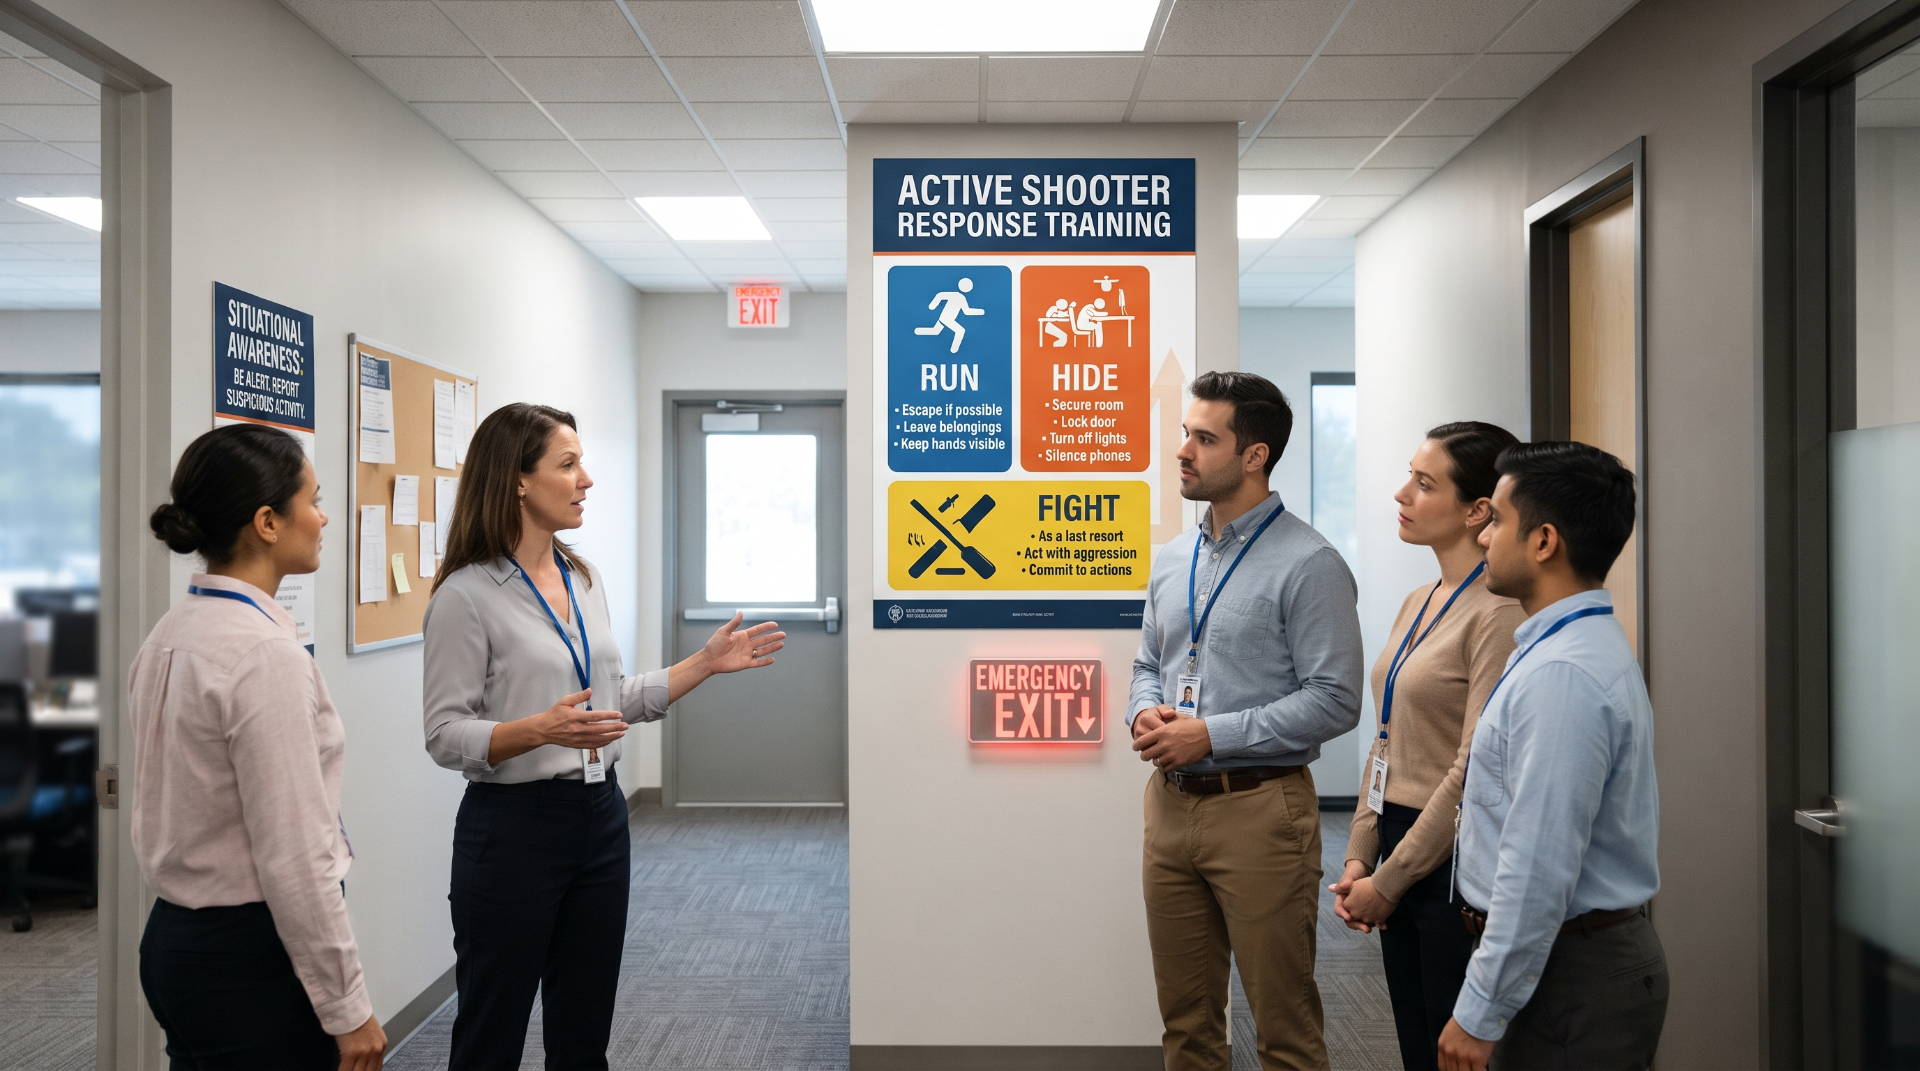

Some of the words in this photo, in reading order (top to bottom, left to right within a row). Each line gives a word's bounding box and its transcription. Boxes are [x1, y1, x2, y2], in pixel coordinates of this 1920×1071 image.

[897, 174, 1013, 206] ACTIVE
[1021, 174, 1171, 206] SHOOTER
[898, 211, 1038, 238] RESPONSE
[1044, 211, 1171, 238] TRAINING
[228, 299, 305, 347] SITUATIONAL
[740, 298, 778, 325] EXIT
[227, 331, 304, 376] AWARENESS:
[233, 367, 245, 386] BE
[245, 370, 271, 392] ALERT.
[272, 376, 300, 398] REPORT
[920, 363, 979, 392] RUN
[1052, 363, 1119, 391] HIDE
[226, 388, 274, 414] SUSPICIOUS
[274, 398, 306, 420] ACTIVITY.
[902, 403, 943, 418] Escape
[945, 403, 954, 416] if
[955, 403, 1003, 418] possible
[1052, 398, 1092, 411] Secure
[1094, 401, 1124, 411] room
[903, 420, 937, 433] Leave
[939, 420, 1002, 436] belongings
[1061, 415, 1089, 428] Lock
[1090, 415, 1117, 428] door
[901, 437, 930, 452] Keep
[931, 437, 967, 450] hands
[968, 437, 1005, 450] visible
[1050, 432, 1075, 444] Turn
[1076, 432, 1093, 444] off
[1095, 432, 1127, 447] lights
[1045, 448, 1087, 462] Silence
[1089, 448, 1131, 463] phones
[1038, 494, 1121, 522] FIGHT
[1038, 529, 1053, 542] As
[1055, 532, 1063, 542] a
[1065, 529, 1087, 542] last
[1088, 530, 1124, 542] resort
[1024, 547, 1044, 560] Act
[1045, 546, 1071, 560] with
[1073, 547, 1137, 562] aggression
[1029, 563, 1074, 576] Commit
[1075, 564, 1087, 576] to
[1089, 563, 1132, 576] actions
[976, 664, 1095, 692] EMERGENCY
[995, 692, 1075, 738] EXIT
